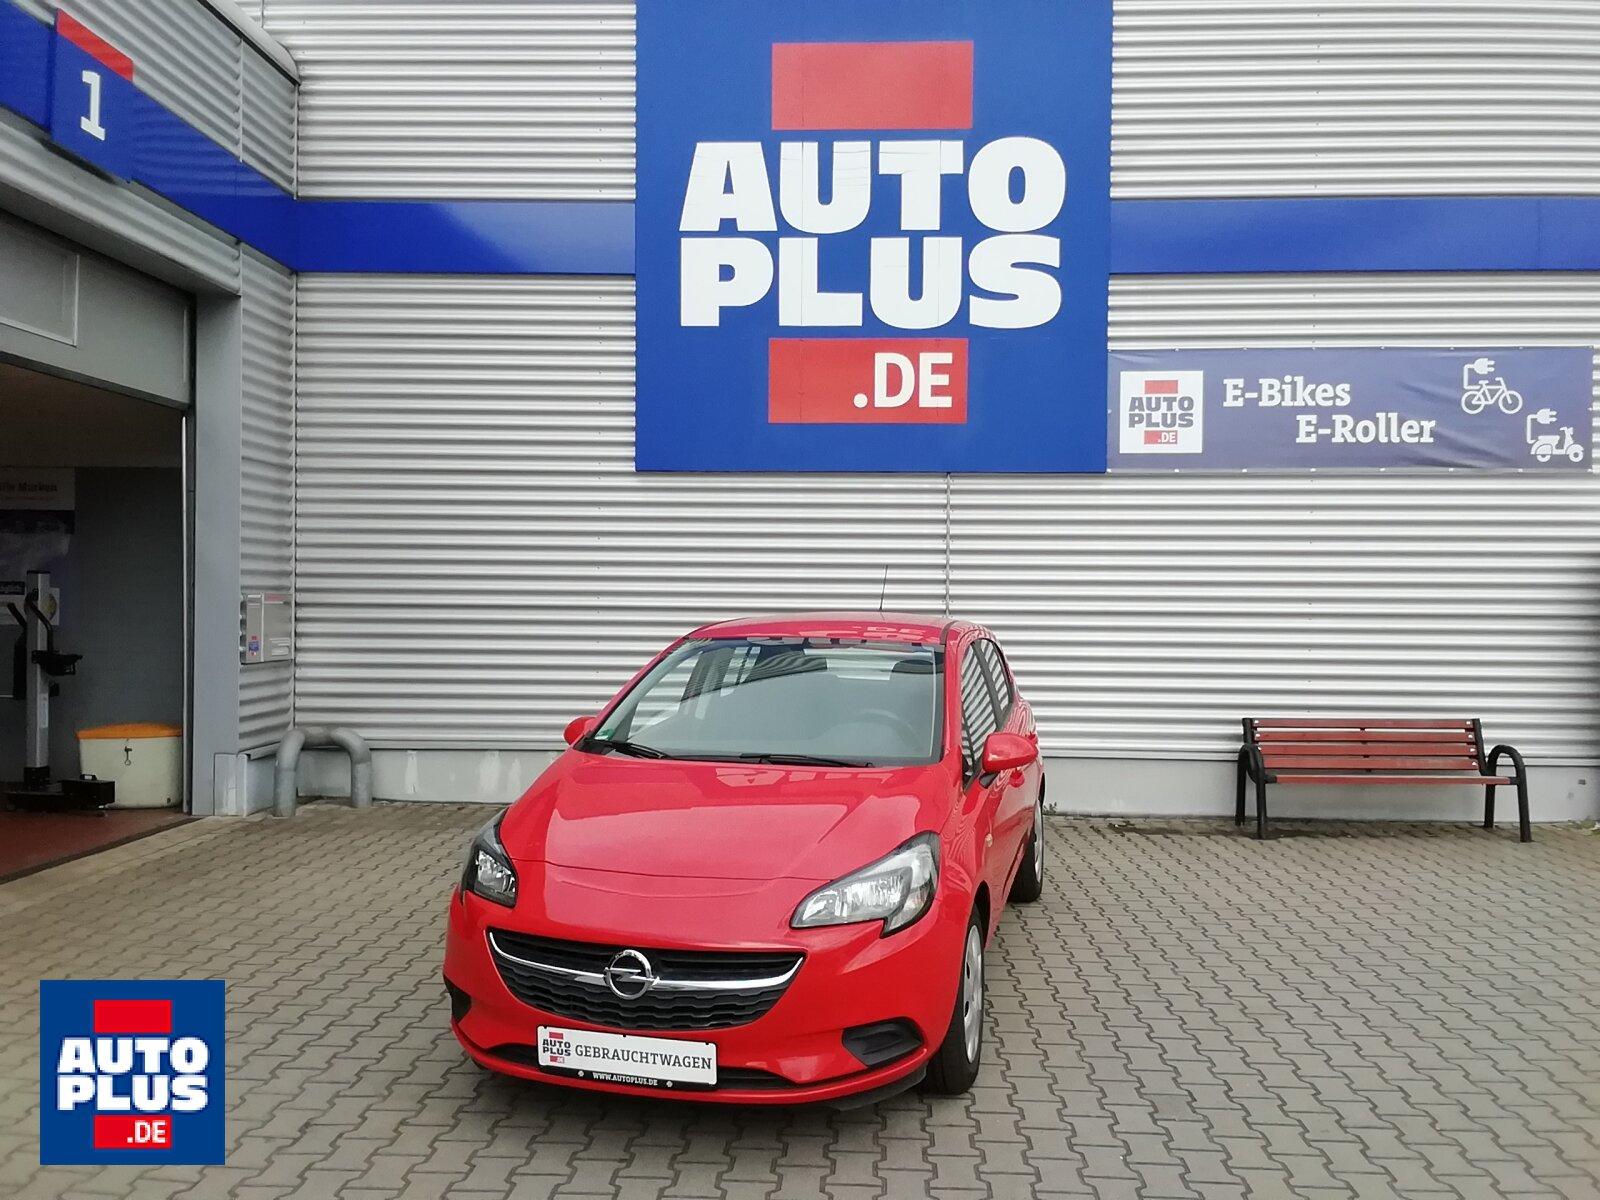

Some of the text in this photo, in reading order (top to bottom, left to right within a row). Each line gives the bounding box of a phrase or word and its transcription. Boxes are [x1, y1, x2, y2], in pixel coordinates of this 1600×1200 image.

[80, 69, 106, 141] 1
[678, 136, 1066, 234] AUTO
[680, 234, 1062, 329] PLUS
[853, 352, 953, 408] .DE
[1223, 375, 1350, 407] E-Bikes
[1128, 396, 1194, 412] AUTO
[1128, 412, 1194, 428] PLUS
[1295, 412, 1436, 444] E-Roller
[1157, 432, 1176, 443] .DE
[542, 1038, 571, 1049] AUTO
[542, 1046, 571, 1057] PLUS
[575, 1044, 712, 1070] GEBRAUCHTWAGEN
[592, 1072, 658, 1086] WWW.AUTOPLUS.DE
